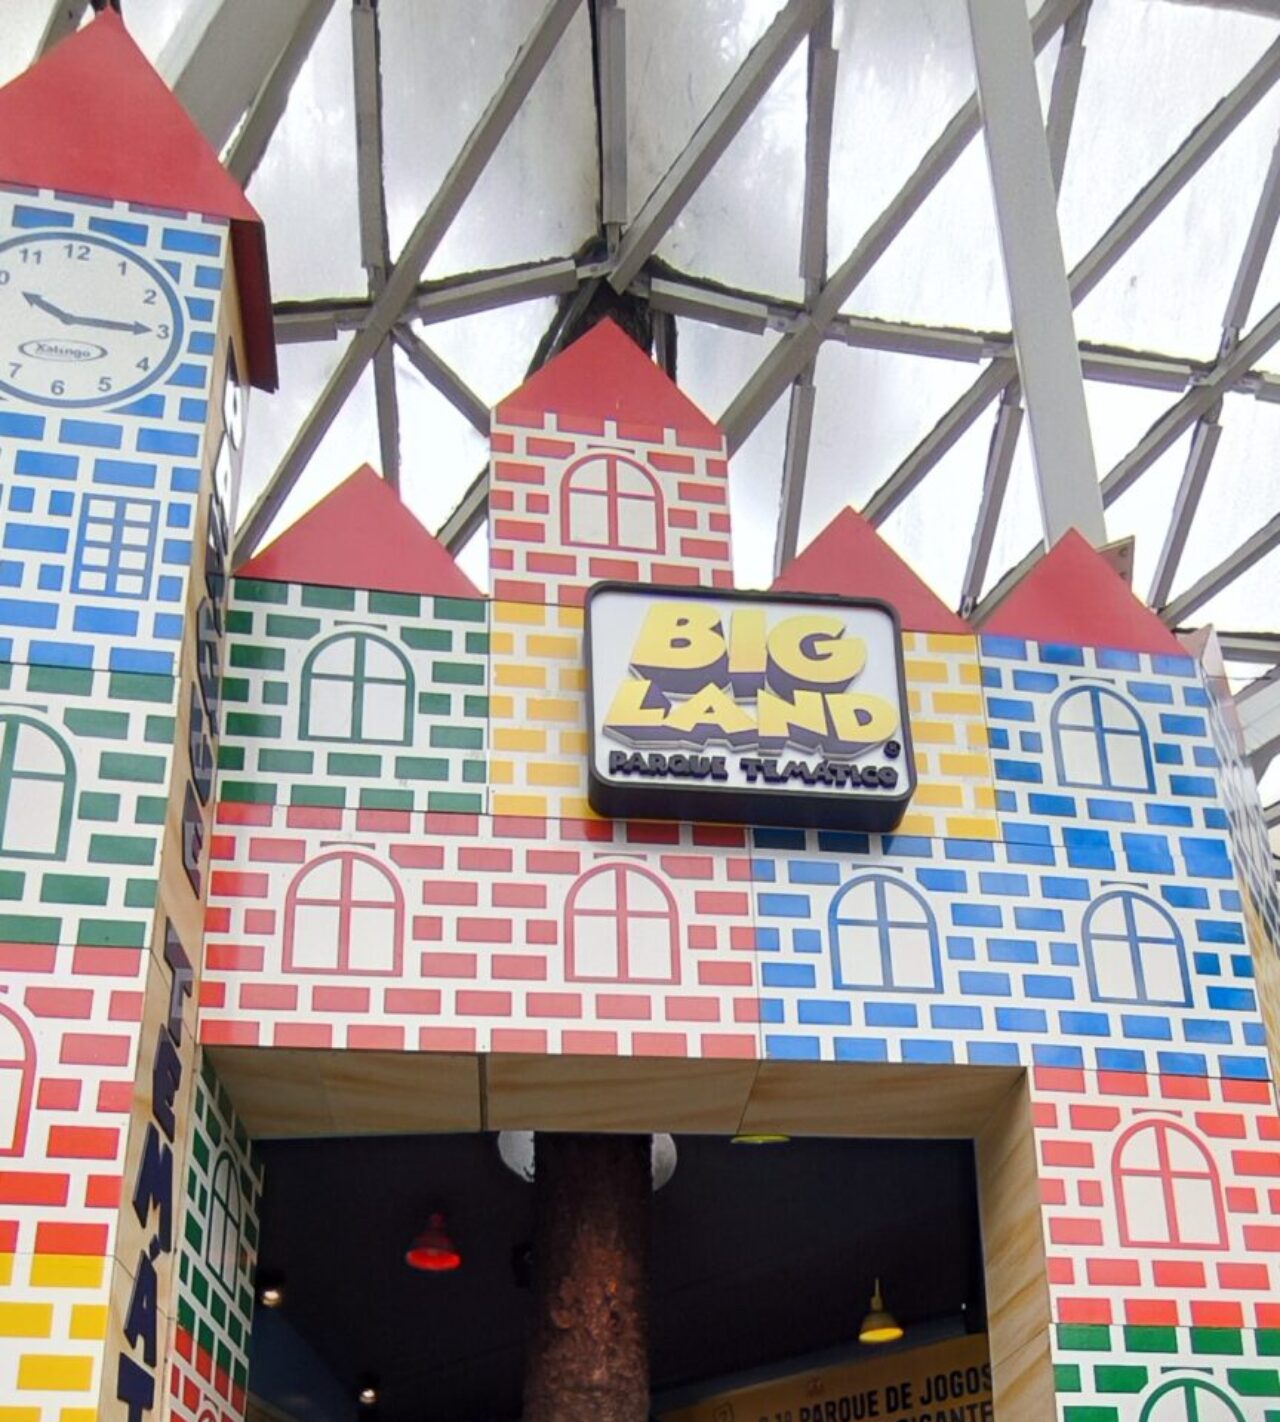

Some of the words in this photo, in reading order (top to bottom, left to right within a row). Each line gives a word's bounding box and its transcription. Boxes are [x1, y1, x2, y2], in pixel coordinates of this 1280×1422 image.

[19, 248, 42, 265] 11
[63, 244, 91, 261] 12
[117, 261, 127, 276] 1
[143, 289, 157, 305] 2
[156, 324, 169, 339] 3
[8, 363, 22, 378] 7
[136, 357, 150, 372] 4
[51, 380, 65, 395] 6
[98, 377, 112, 391] 5
[629, 602, 868, 690] BIG
[603, 680, 899, 754] LAND
[608, 750, 728, 781] PARQUE
[740, 757, 899, 789] TEMÁTICO
[885, 1382, 913, 1413] DE
[920, 1362, 993, 1406] JOGOS
